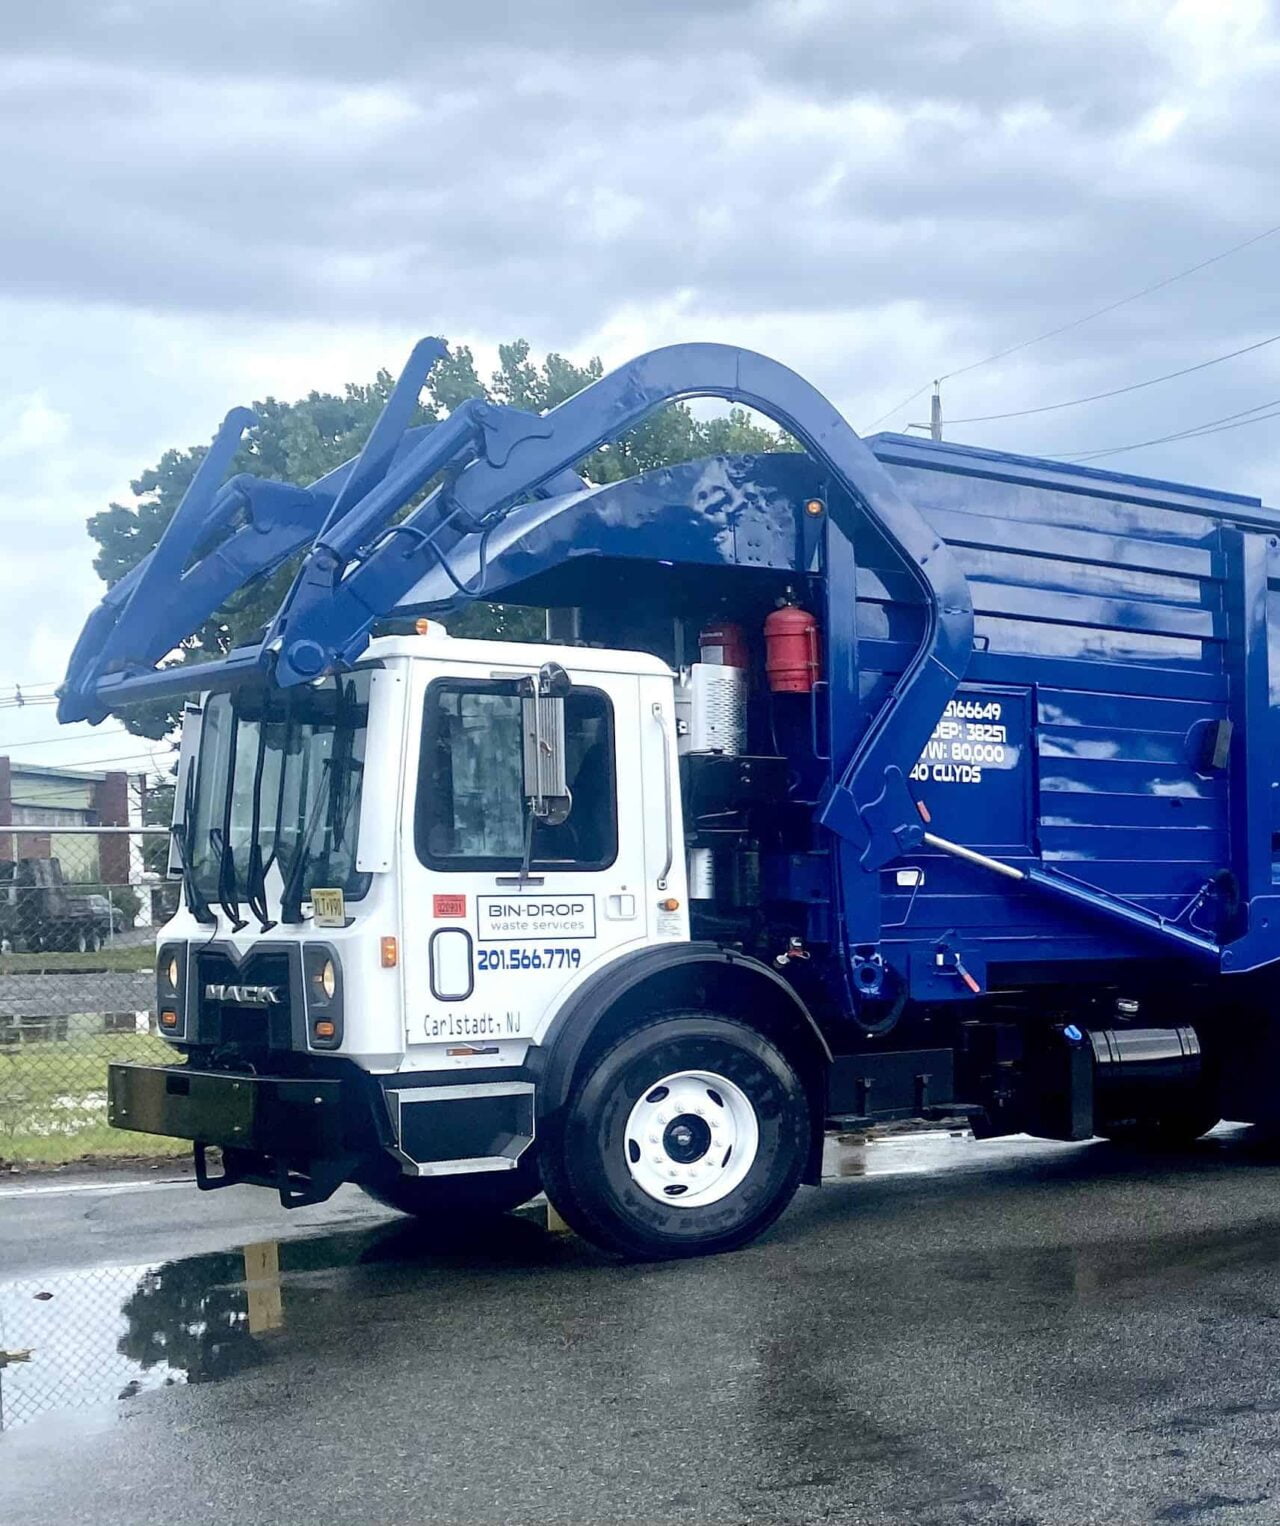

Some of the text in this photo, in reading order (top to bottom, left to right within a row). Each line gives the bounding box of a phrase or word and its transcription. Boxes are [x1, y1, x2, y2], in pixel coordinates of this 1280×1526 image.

[966, 723, 1007, 743] 38251
[951, 743, 1005, 764] 80,000
[909, 763, 929, 781] 40
[489, 903, 584, 917] BIN-DROP
[491, 920, 585, 931] waste services
[477, 948, 581, 970] 201.566.7719
[205, 984, 281, 1003] MACK
[506, 1011, 521, 1033] NJ
